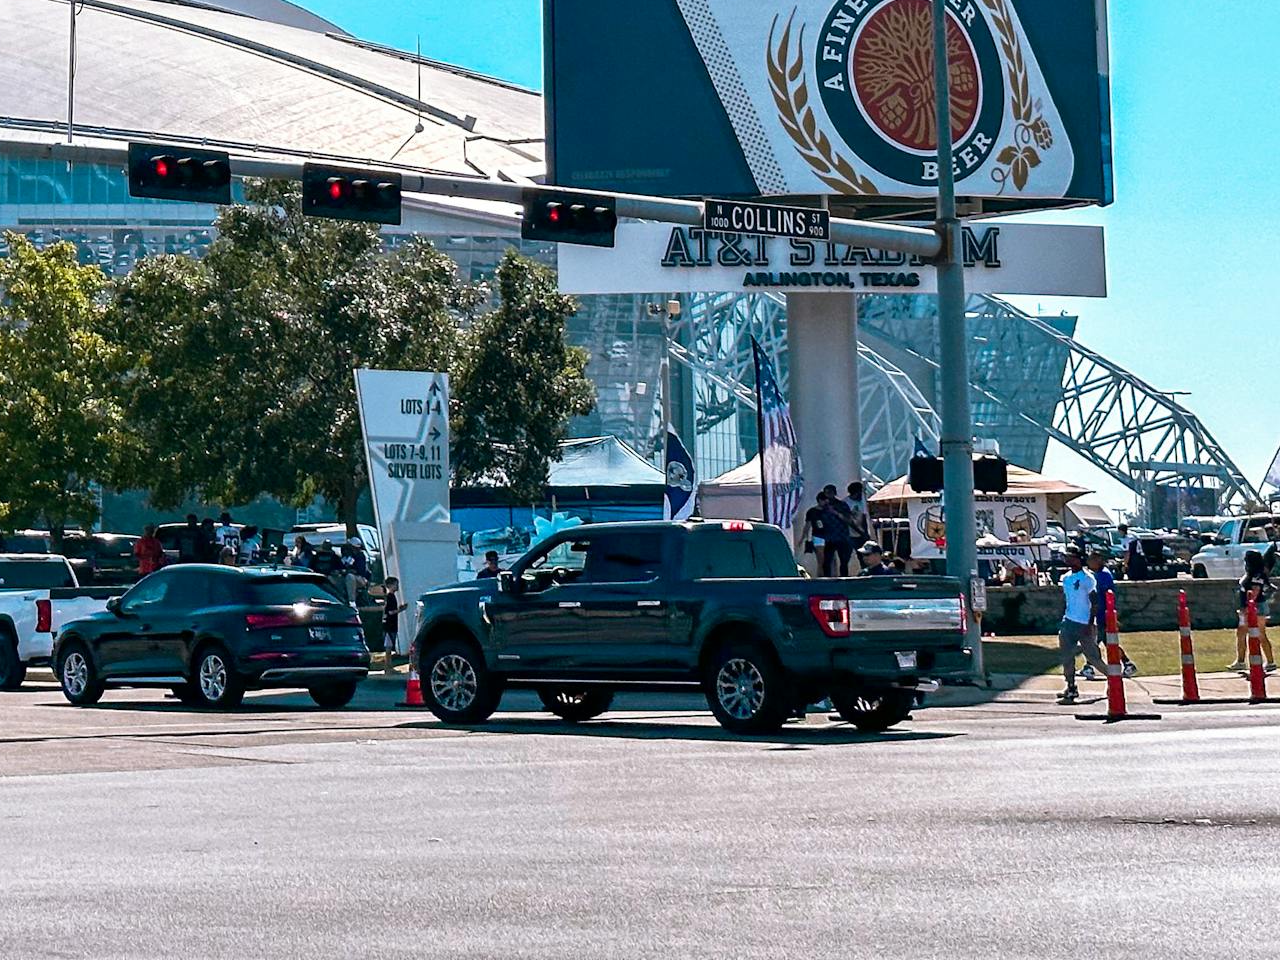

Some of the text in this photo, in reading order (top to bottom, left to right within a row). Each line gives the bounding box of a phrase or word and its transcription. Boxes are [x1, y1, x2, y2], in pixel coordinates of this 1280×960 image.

[824, 72, 845, 92] A
[711, 217, 729, 228] 1000
[717, 205, 821, 235] N COLLINS ST
[808, 226, 824, 237] 900
[661, 227, 776, 267] AT&T
[743, 272, 920, 289] ARLINGTON, TEXAS
[401, 399, 442, 416] LOTS 1-4
[384, 443, 441, 461] LOTS 7-9, 11
[388, 463, 442, 480] SILVER LOTS
